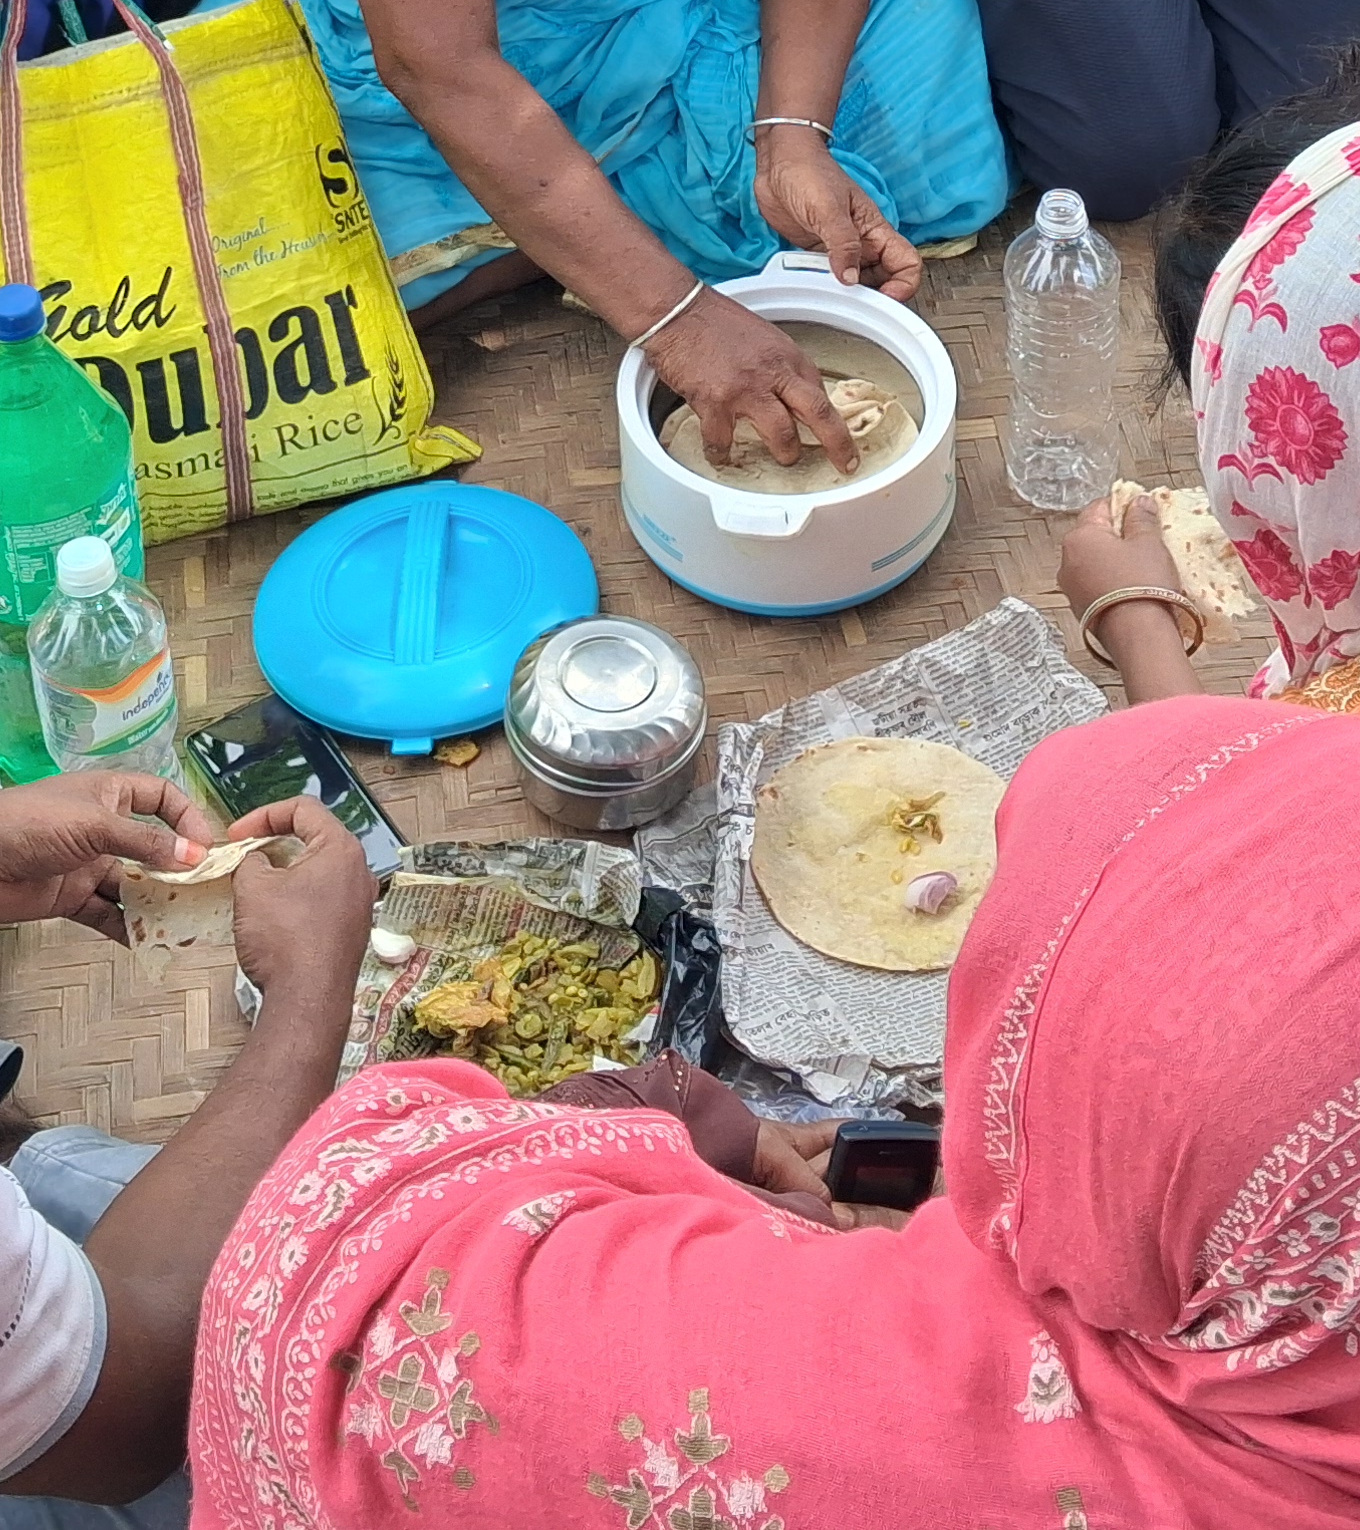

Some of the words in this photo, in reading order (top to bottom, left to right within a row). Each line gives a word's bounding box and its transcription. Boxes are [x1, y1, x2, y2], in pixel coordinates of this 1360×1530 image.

[253, 246, 277, 266] the
[38, 266, 177, 344] Gold
[134, 433, 261, 481] asmai
[274, 411, 364, 459] Rice
[332, 477, 349, 487] that
